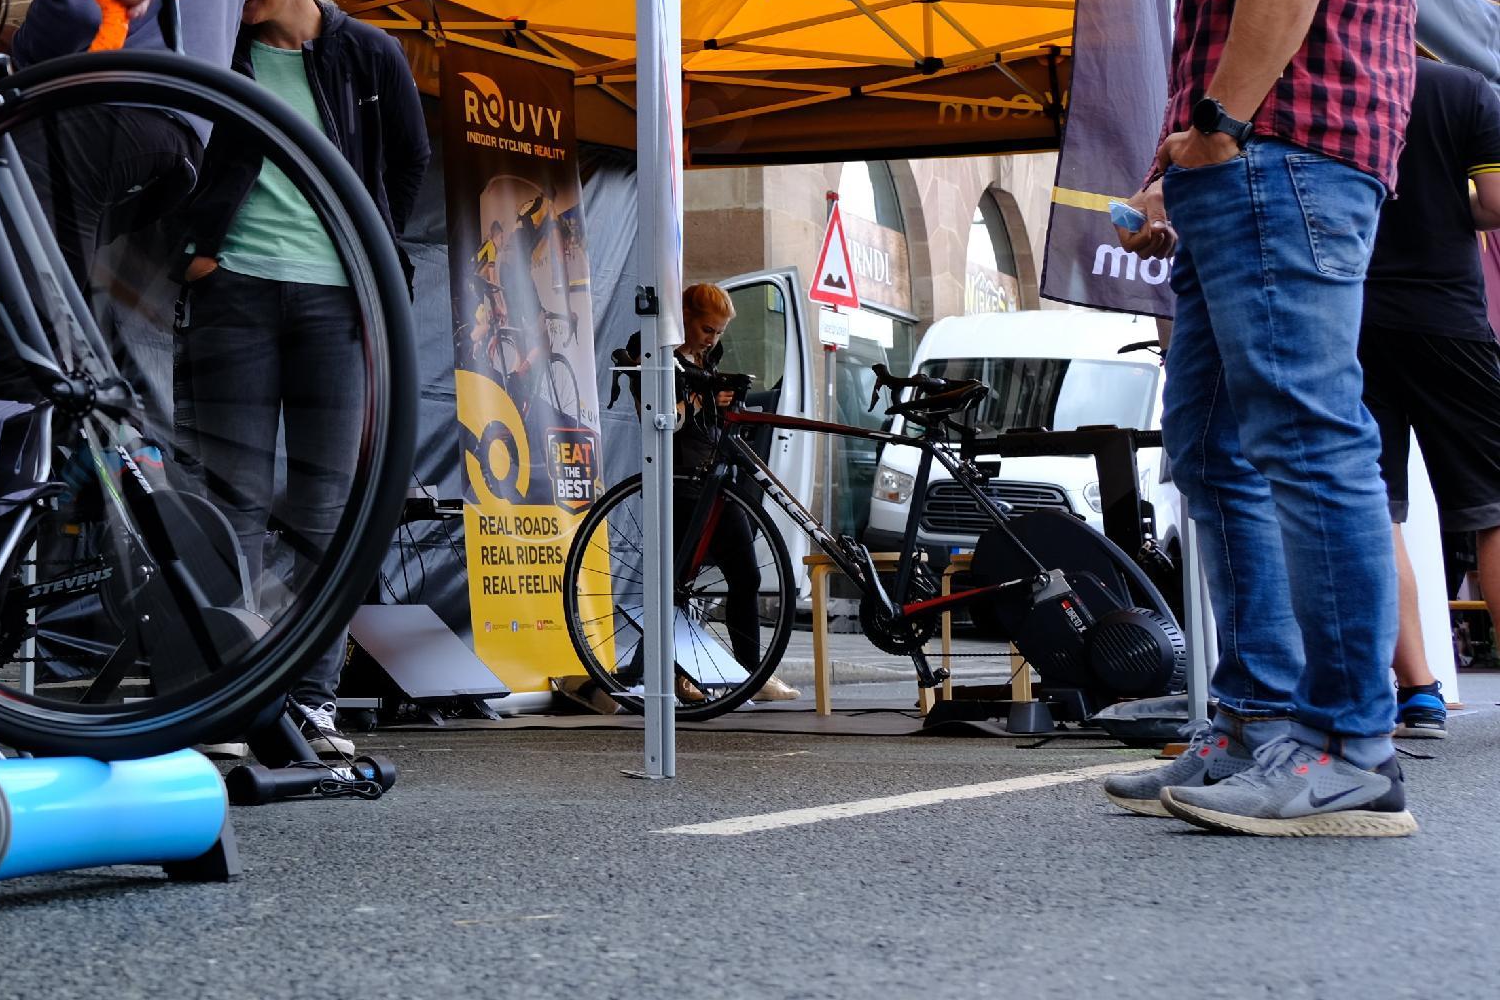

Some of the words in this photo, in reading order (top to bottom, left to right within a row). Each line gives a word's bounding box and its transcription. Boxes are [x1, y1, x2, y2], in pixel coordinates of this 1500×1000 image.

[463, 83, 562, 140] ROUVY
[466, 130, 498, 148] INDOOR
[498, 137, 532, 155] CYCLING
[533, 144, 566, 160] REALITY
[551, 441, 592, 465] BEAT
[564, 466, 581, 479] THE
[557, 479, 593, 500] BEST
[753, 463, 832, 543] TREK
[479, 515, 513, 536] REAL
[514, 516, 562, 536] ROADS.
[481, 545, 515, 566] REAL
[516, 546, 567, 566] RIDERS.
[28, 567, 114, 598] STEVENS
[483, 575, 517, 596] REAL
[518, 575, 564, 595] FEELIN
